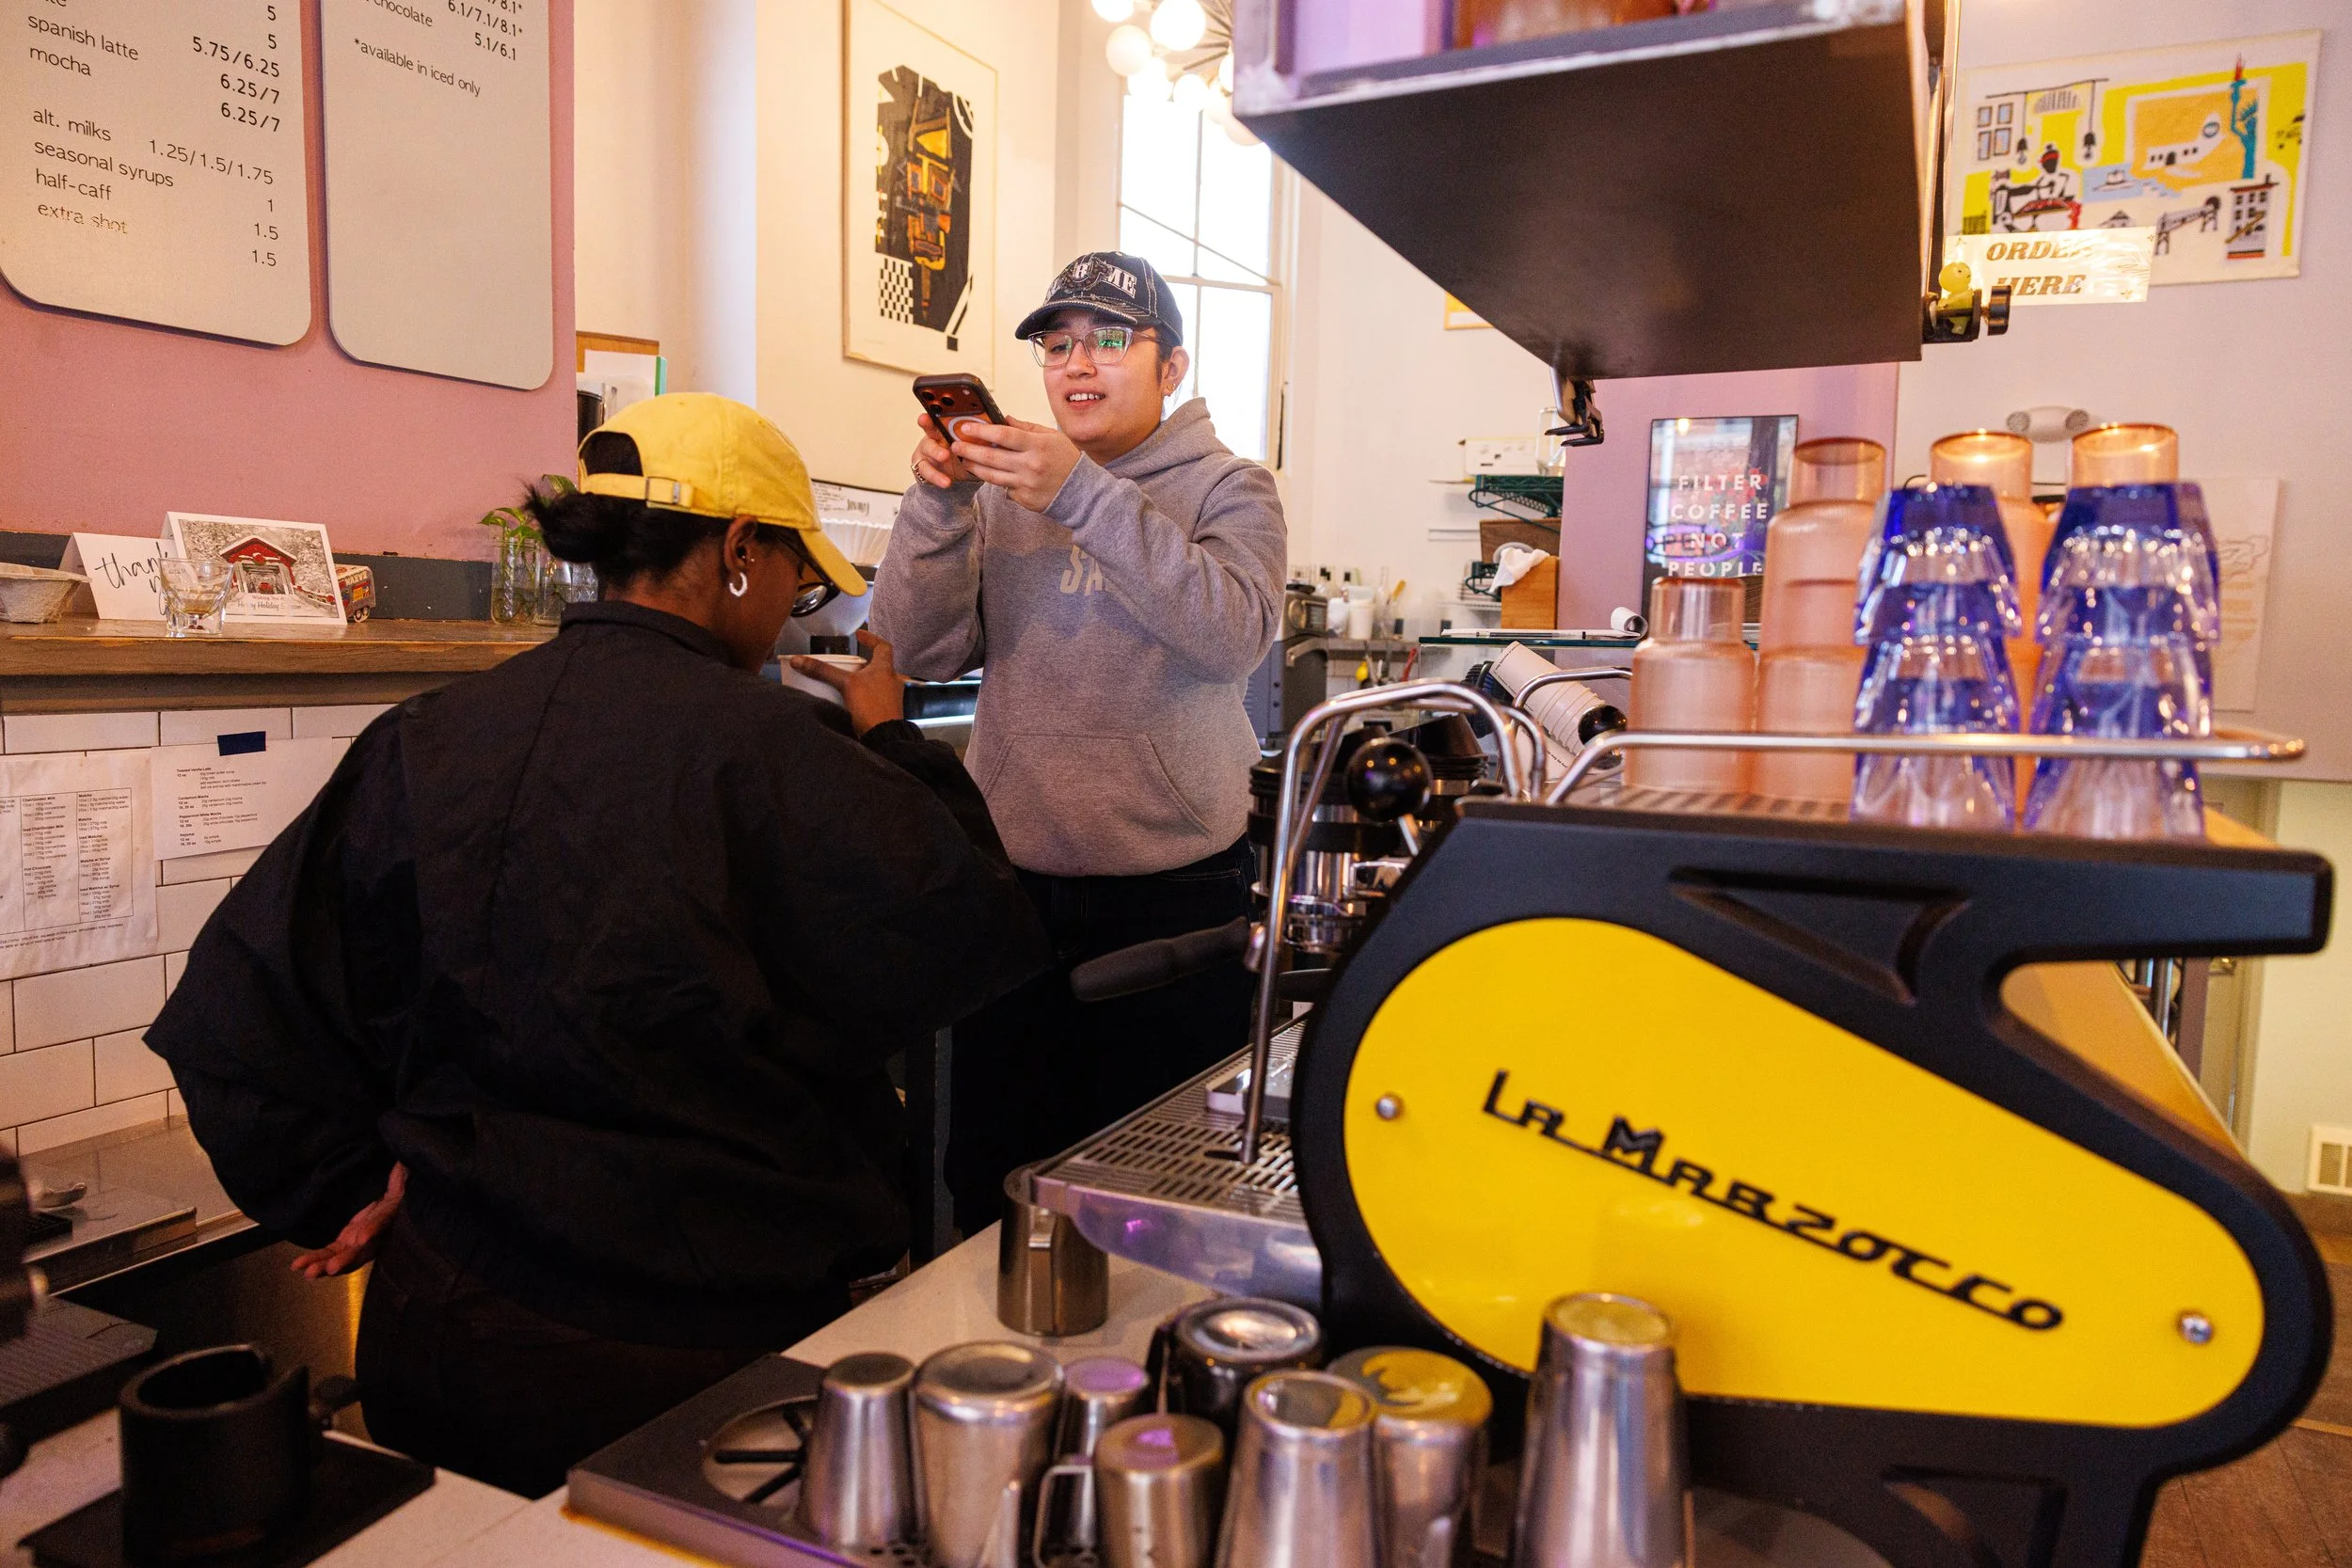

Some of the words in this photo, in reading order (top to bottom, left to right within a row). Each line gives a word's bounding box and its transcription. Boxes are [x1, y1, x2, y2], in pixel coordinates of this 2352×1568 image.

[267, 6, 276, 21] 5
[28, 15, 95, 47] spanish
[101, 35, 139, 60] latte
[268, 34, 277, 49] 5
[474, 32, 516, 61] 5.1/6.1
[29, 47, 91, 76] mocha
[192, 36, 279, 77] 5.75/6.25
[220, 73, 279, 104] 6.25/7
[417, 60, 427, 76] in
[431, 66, 453, 86] iced
[458, 79, 481, 97] only
[33, 109, 59, 128] alt.
[68, 119, 111, 141] milks
[221, 103, 279, 132] 6.25/7
[34, 142, 113, 171] seasonal
[119, 163, 174, 187] syrups
[150, 140, 273, 184] 1.25/1.5/1.75
[36, 168, 111, 200] half-caff
[38, 203, 84, 225] extra
[91, 214, 128, 234] shot
[267, 199, 274, 213] 1
[254, 222, 278, 241] 1.5
[252, 249, 277, 267] 1.5
[1997, 275, 2086, 296] HERE
[1678, 474, 1761, 491] FILTER
[1671, 503, 1769, 519] COFFEE
[1691, 532, 1743, 548] NOT
[1667, 562, 1763, 577] PEOPLE
[258, 601, 279, 610] Holiday
